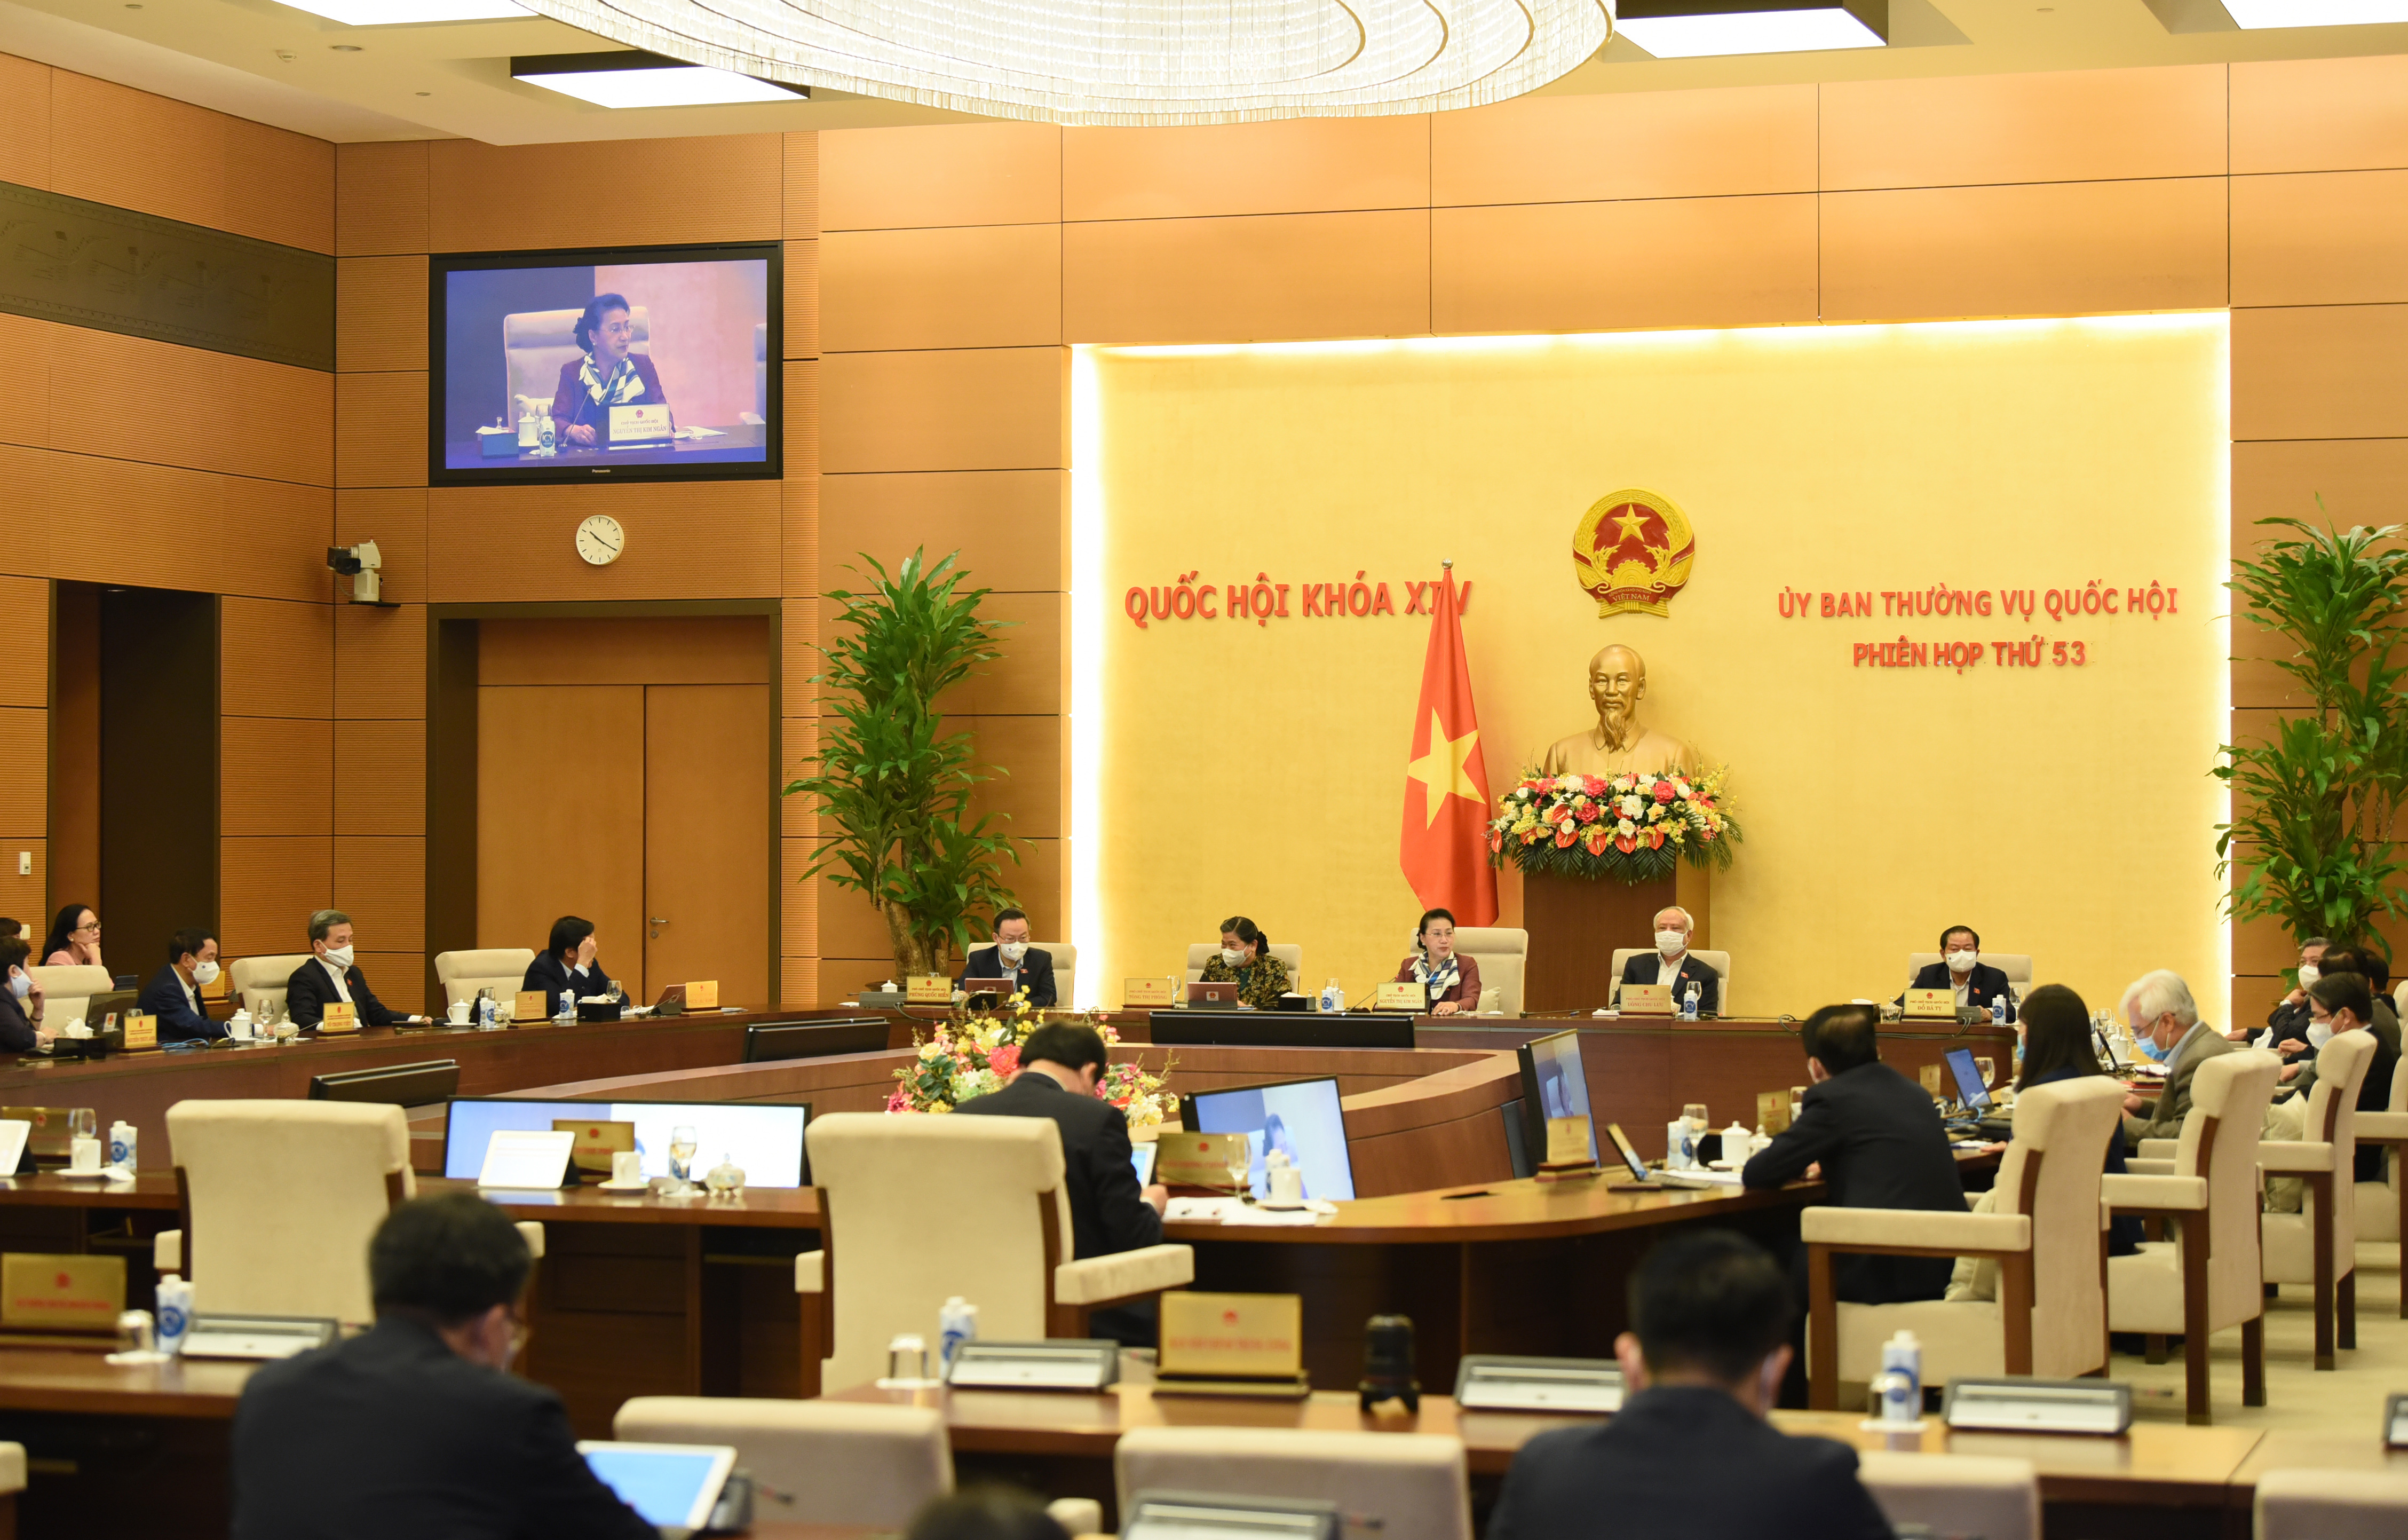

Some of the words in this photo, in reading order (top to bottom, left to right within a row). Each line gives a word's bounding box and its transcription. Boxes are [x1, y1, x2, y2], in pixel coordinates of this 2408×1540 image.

[542, 434, 553, 442] ICY
[1126, 571, 1217, 628] QUỐC
[1227, 572, 1290, 627] HỘI
[1303, 571, 1395, 617] KHÓA
[1612, 593, 1630, 602] VIỆT
[1779, 586, 1812, 618] ỦY
[1821, 592, 1872, 618] BAN
[1881, 583, 1992, 617] THƯỜNG
[2001, 590, 2034, 622] VỤ
[2045, 579, 2118, 621] QUỐC
[2128, 580, 2177, 620] HỘI
[1853, 635, 1927, 667] PHIÊN
[1934, 642, 1984, 675] HỌP
[1991, 635, 2045, 667] THỨ
[2053, 641, 2086, 666] 53
